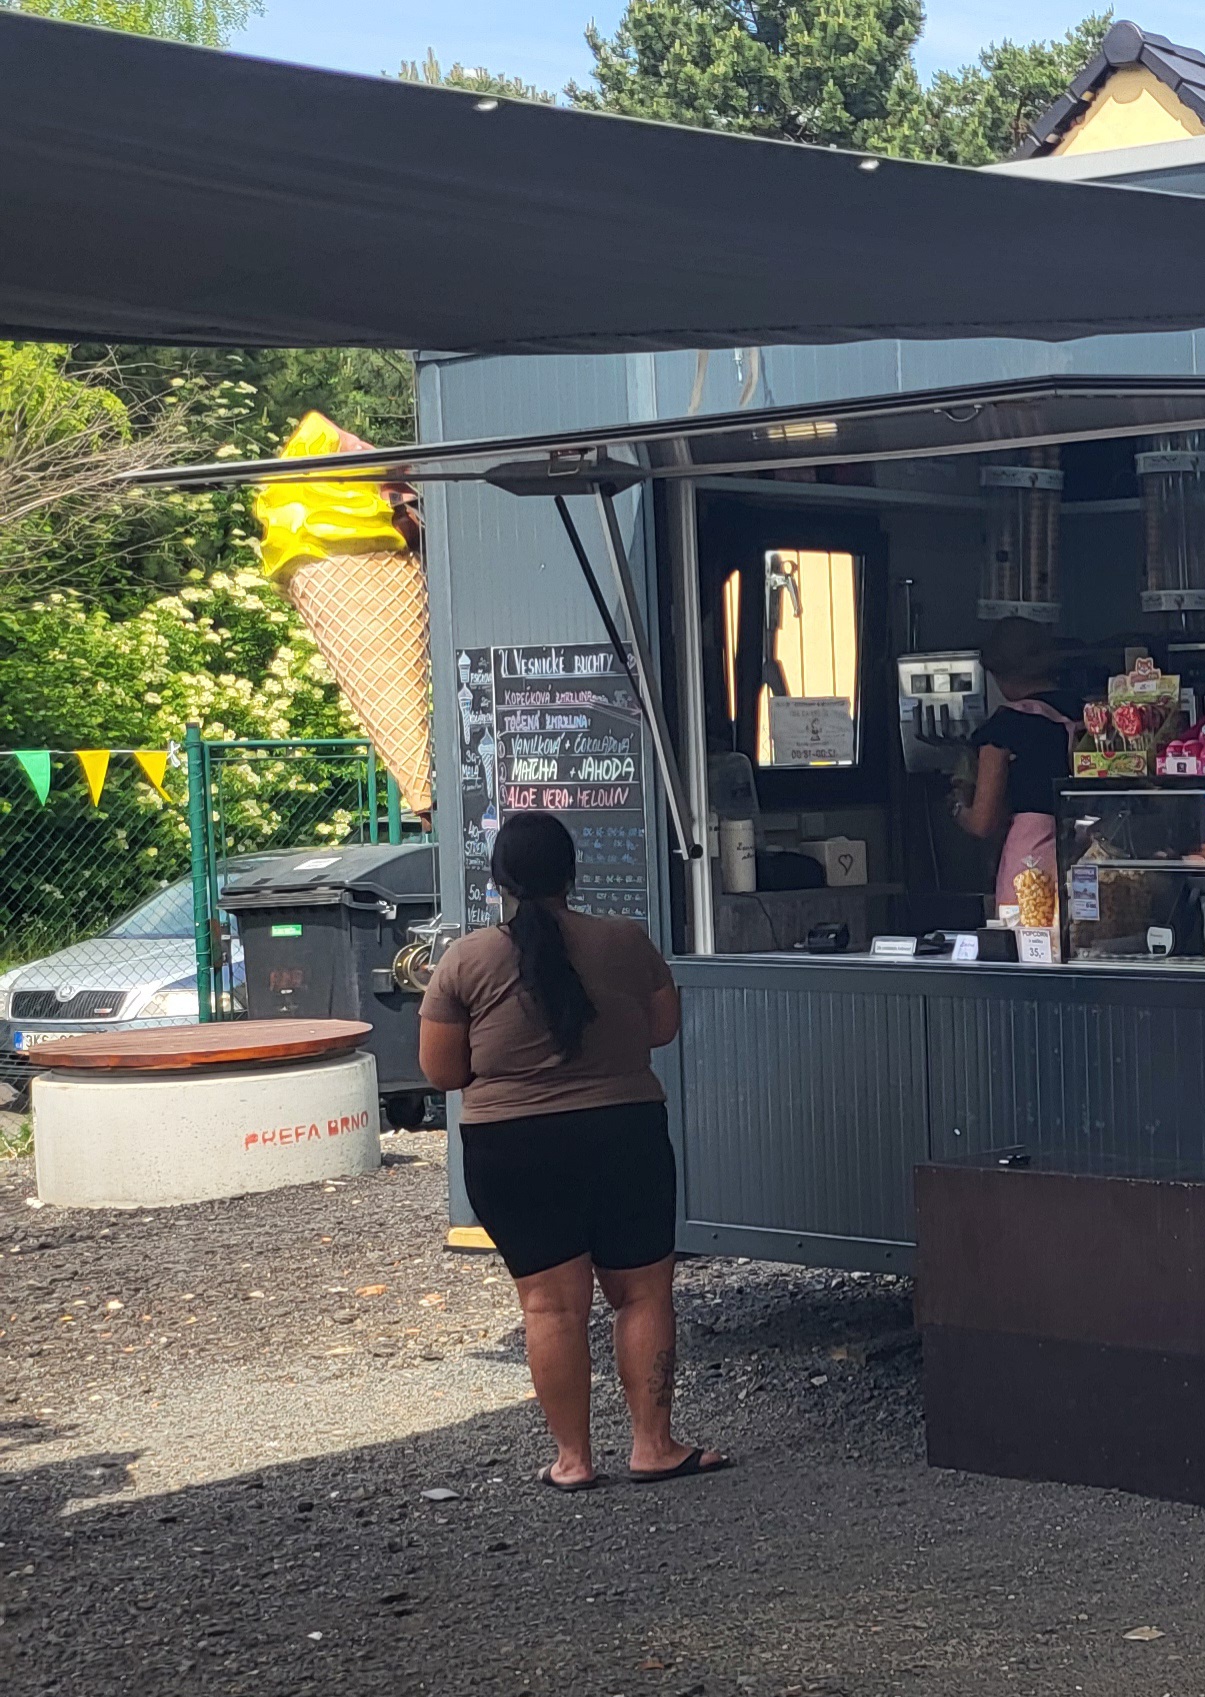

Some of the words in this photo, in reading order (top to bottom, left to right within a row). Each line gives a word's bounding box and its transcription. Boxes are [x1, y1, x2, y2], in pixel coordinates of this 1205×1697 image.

[574, 653, 613, 673] BUCHTY
[504, 684, 551, 705] KOPEČKOVÁ
[556, 691, 592, 703] ZMRZLINA
[504, 710, 540, 730] TOČENÁ
[511, 757, 558, 781] MATCHA
[578, 756, 635, 782] JAHODA
[507, 786, 537, 809] ALOE
[543, 788, 569, 809] VERA
[577, 787, 629, 808] MELOUN
